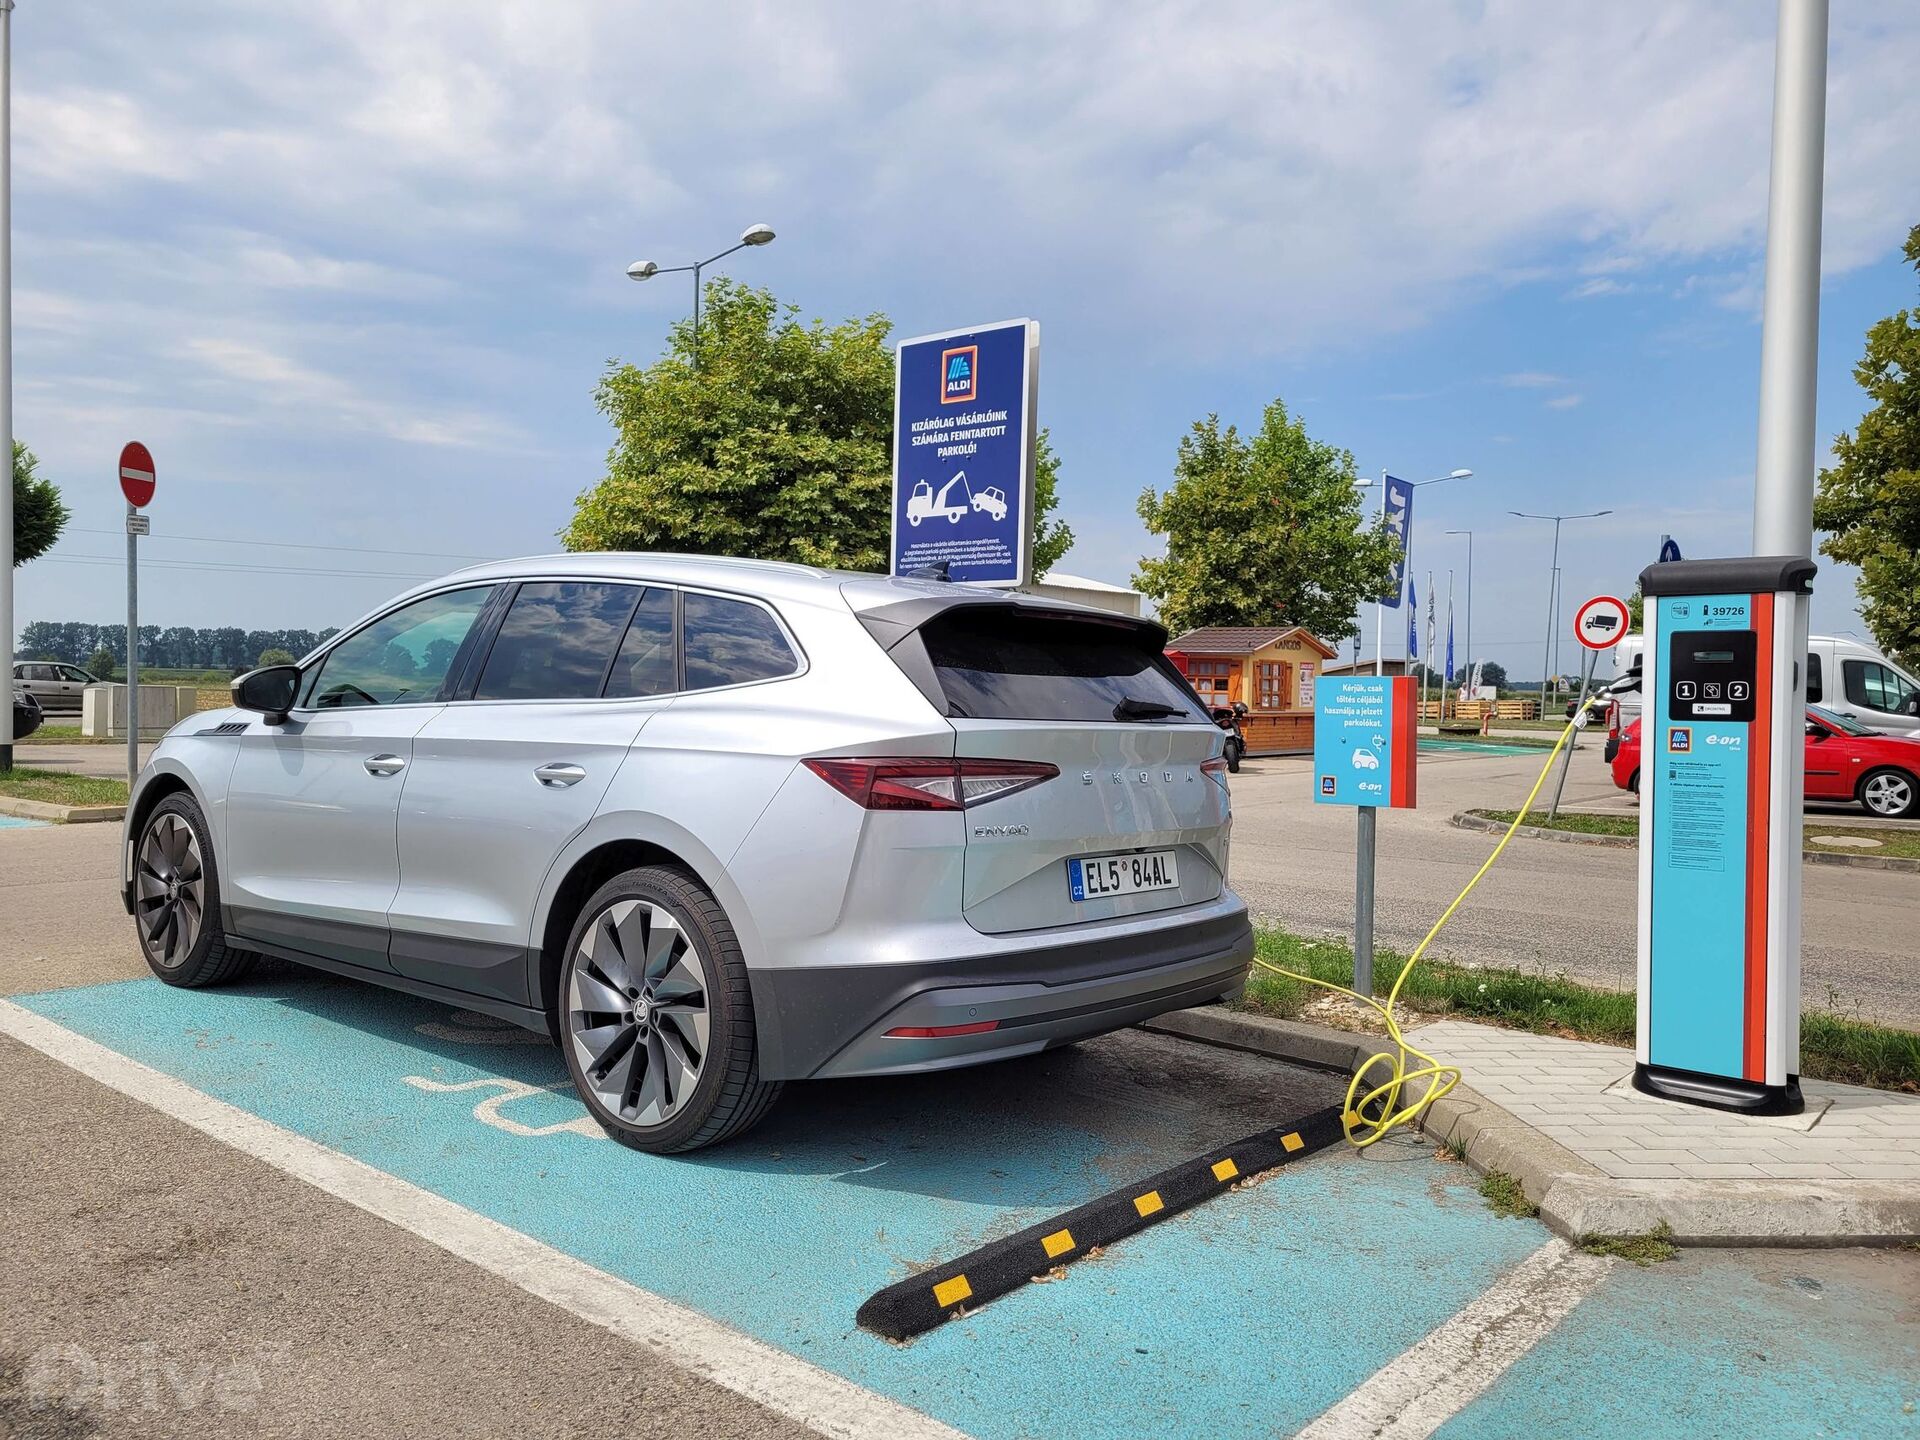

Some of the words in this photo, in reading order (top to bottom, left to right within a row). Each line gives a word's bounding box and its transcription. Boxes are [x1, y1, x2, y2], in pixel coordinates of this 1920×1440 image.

[947, 379, 971, 392] ALDI
[911, 416, 954, 432] KIZÁRÓLAG
[956, 408, 1008, 426] VÁSÁRLÓINK
[911, 431, 949, 447] SZÁMÁRA
[950, 425, 1006, 441] FENNTARTOTT
[937, 441, 977, 457] PARKOLÓ!
[1712, 607, 1745, 616] 39726
[1342, 683, 1366, 693] Kérjük,
[1367, 684, 1383, 692] csak
[1682, 685, 1690, 696] 1
[1733, 685, 1742, 696] 2
[1336, 696, 1355, 704] töltés
[1356, 696, 1383, 705] céljából
[1324, 706, 1355, 716] használja
[1360, 707, 1383, 716] jelzett
[1343, 719, 1383, 728] parkolókat.
[974, 823, 1029, 838] ENYAQ
[1085, 860, 1120, 894] EL5
[1131, 855, 1172, 888] 84AL
[1073, 885, 1083, 896] CZ
